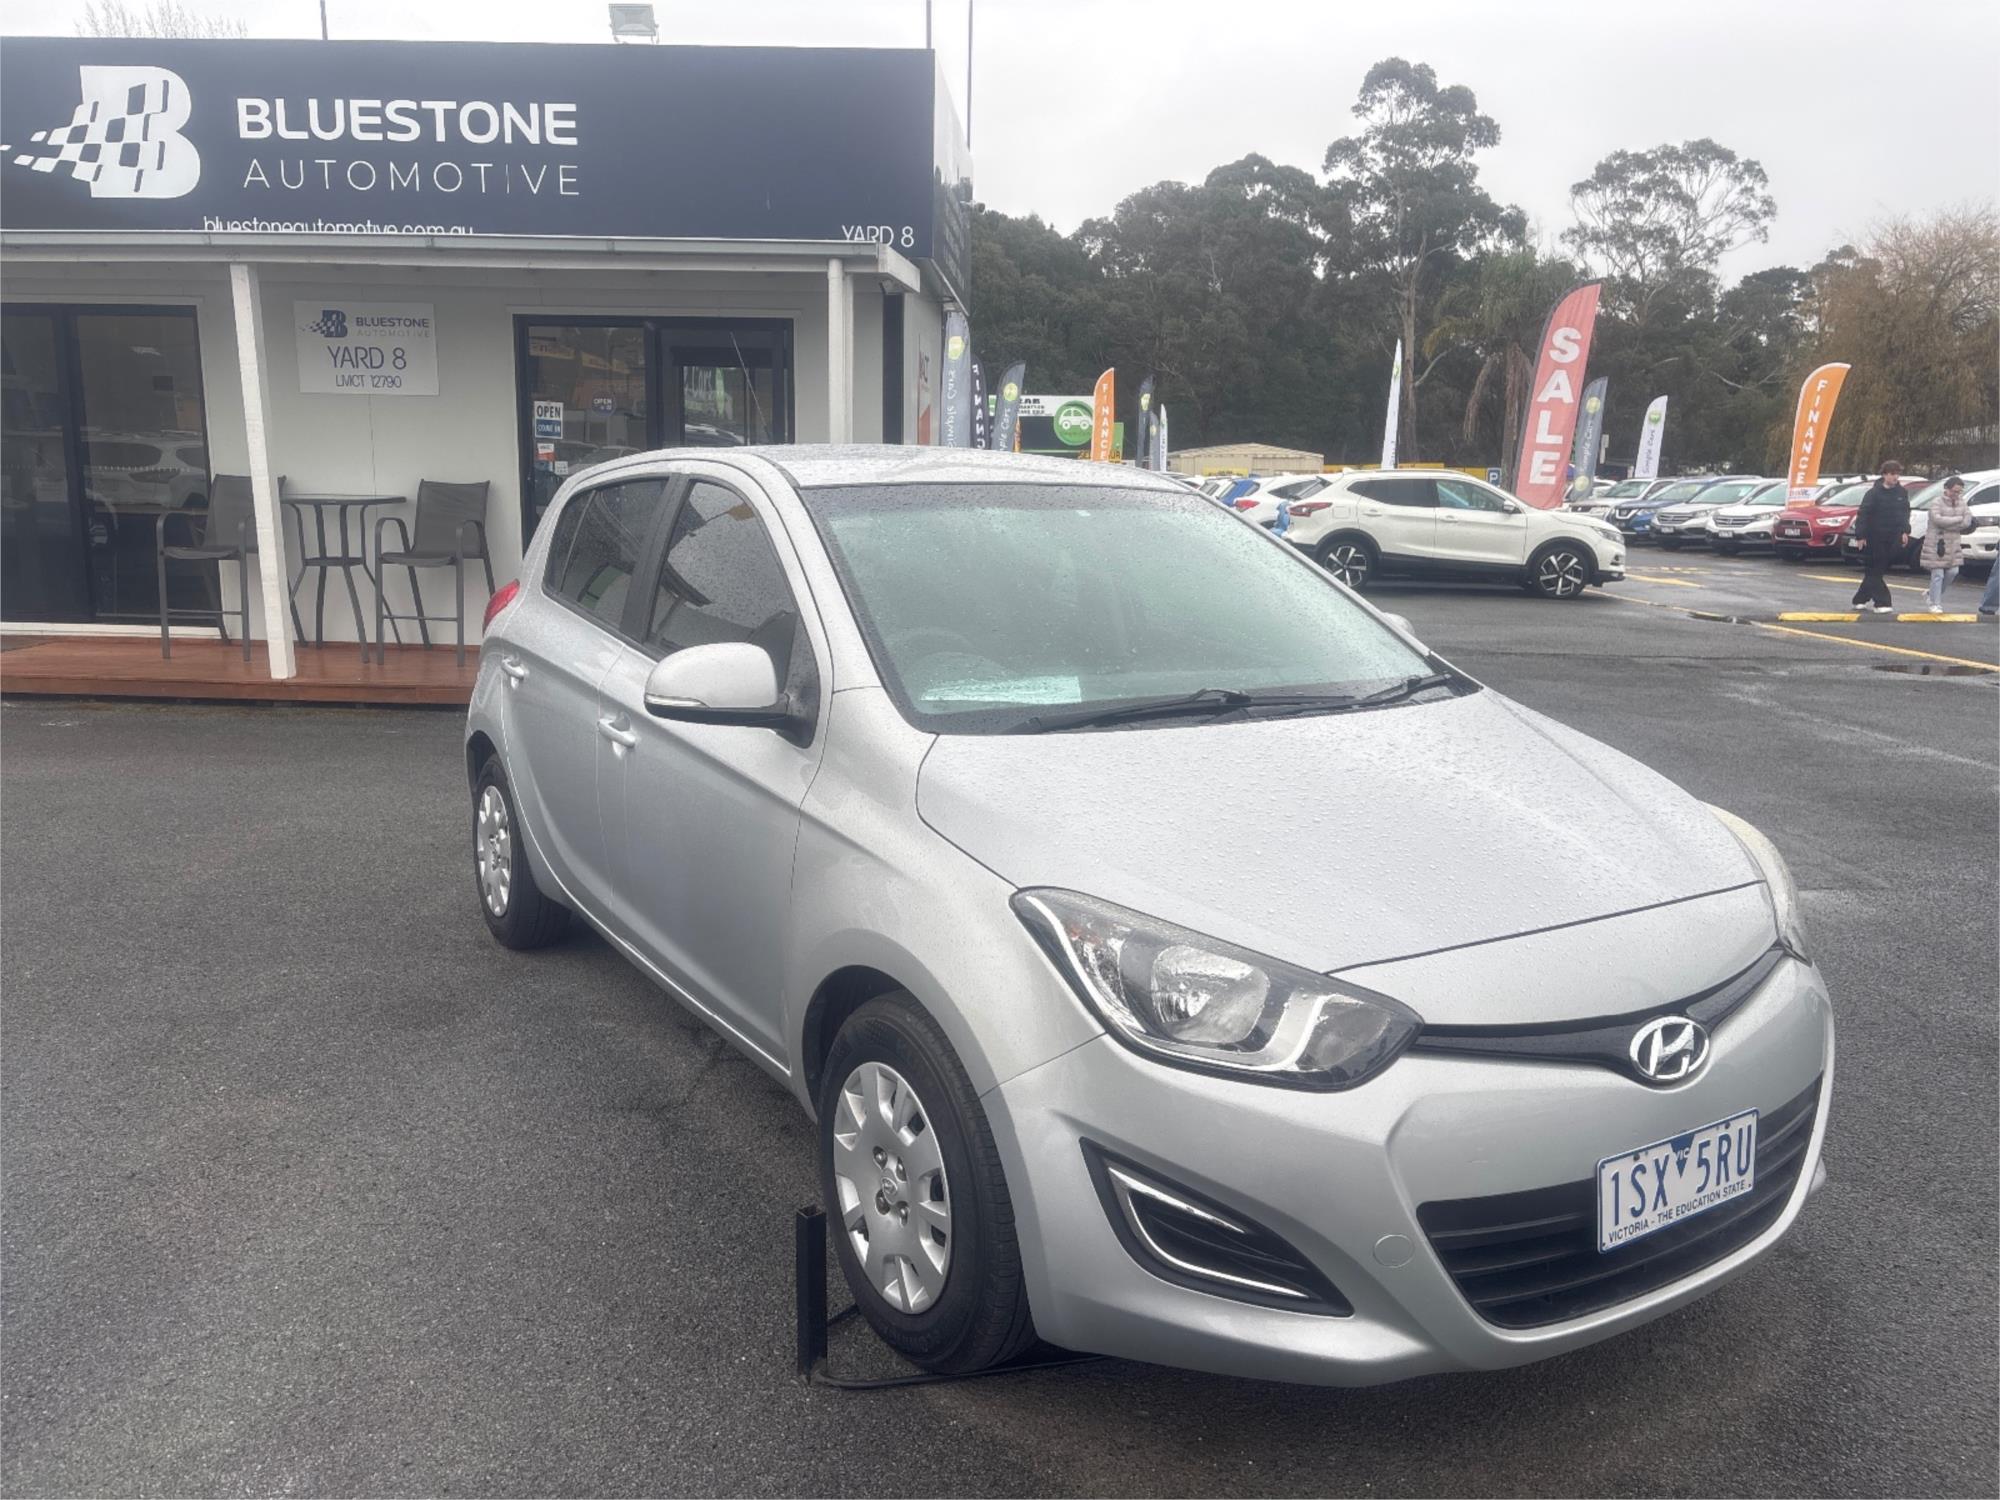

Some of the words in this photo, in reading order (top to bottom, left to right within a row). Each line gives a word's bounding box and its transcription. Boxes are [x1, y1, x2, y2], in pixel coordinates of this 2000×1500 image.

[236, 97, 579, 145] BLUESTONE
[243, 158, 580, 196] AUTOMOTIVE
[203, 215, 474, 234] bluestoneautomotivecomau
[841, 224, 895, 246] YARD
[900, 225, 915, 248] 8
[355, 316, 430, 328] BLUESTONE
[327, 345, 384, 369] YARD
[392, 347, 407, 370] 8
[335, 374, 365, 387] LMCT
[370, 375, 402, 389] 12790
[536, 404, 561, 419] OPEN
[1529, 326, 1582, 485] SALE
[1100, 383, 1109, 460] FINANCE
[1795, 379, 1829, 485] FINANCE
[1489, 472, 1499, 484] P
[1610, 1152, 1670, 1227] 1SX
[1695, 1124, 1752, 1194] 5RU
[1608, 1219, 1650, 1244] VICTORIA
[1657, 1208, 1673, 1224] THE
[1675, 1190, 1721, 1216] EDUCATION
[1722, 1179, 1746, 1198] STATE
